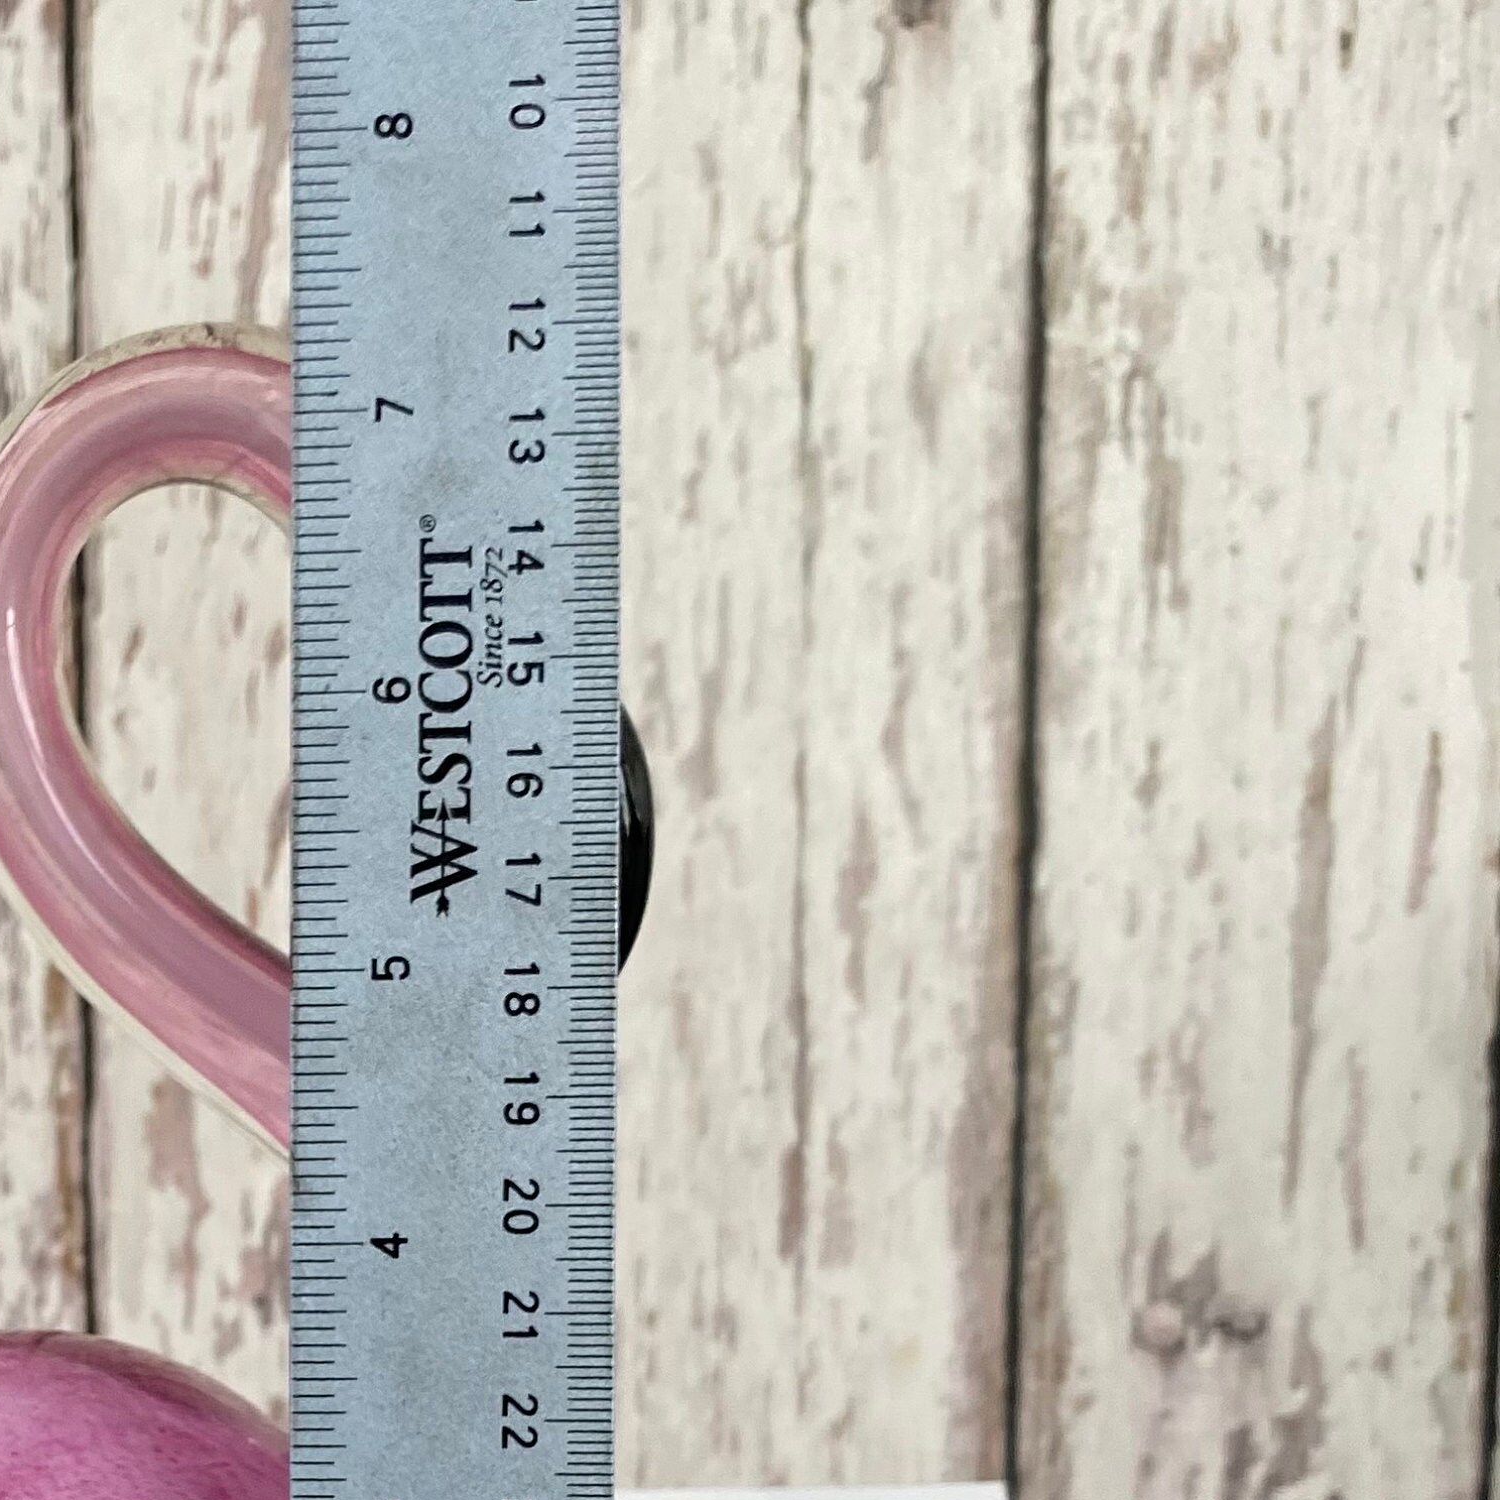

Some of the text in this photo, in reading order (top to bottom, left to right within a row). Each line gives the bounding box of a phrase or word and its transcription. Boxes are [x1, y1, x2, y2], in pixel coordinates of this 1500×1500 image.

[373, 112, 413, 140] 8
[509, 74, 546, 129] 10
[509, 190, 545, 237] 11
[508, 297, 546, 353] 12
[374, 397, 414, 422] 7
[508, 408, 546, 465] 13
[508, 519, 545, 575] 14
[476, 546, 508, 687] Since 1872
[507, 631, 545, 686] 15
[372, 676, 412, 704] 6
[506, 742, 544, 798] 16
[505, 852, 542, 906] 17
[371, 956, 411, 981] 5
[504, 962, 541, 1016] 18
[503, 1072, 540, 1126] 19
[503, 1178, 540, 1235] 20
[370, 1232, 408, 1259] 4
[502, 1291, 540, 1338] 21
[502, 1394, 538, 1449] 22
